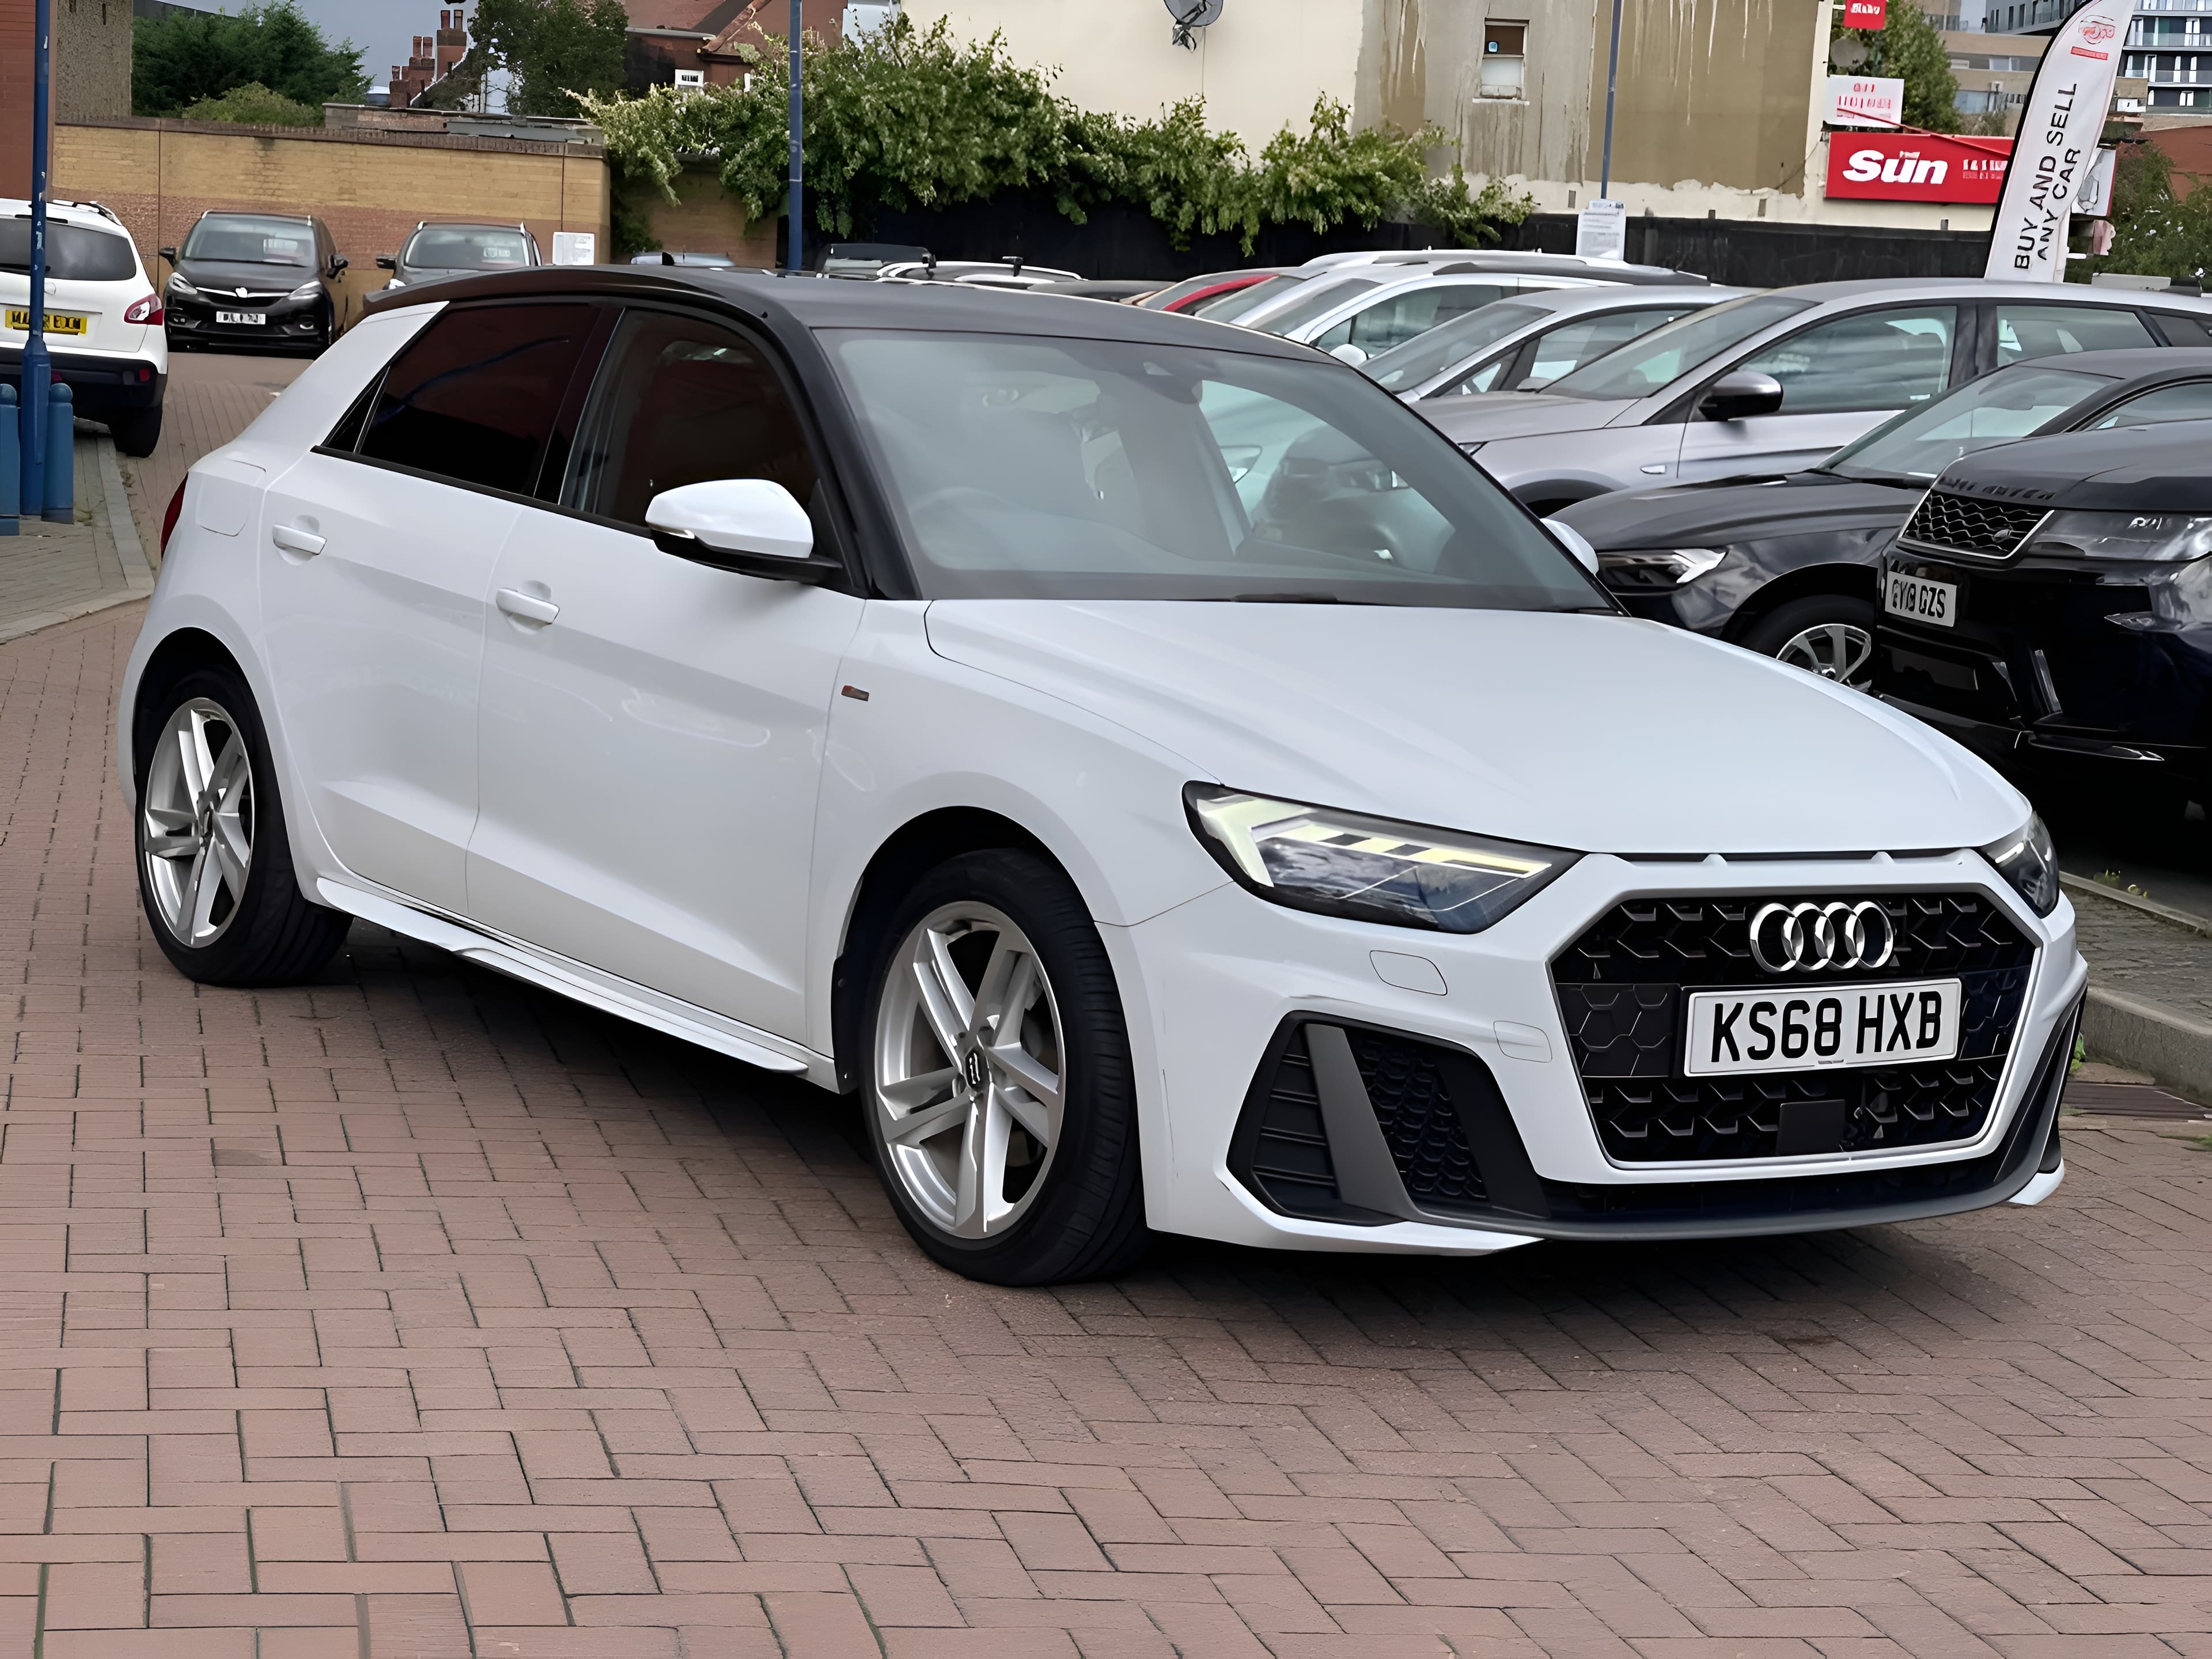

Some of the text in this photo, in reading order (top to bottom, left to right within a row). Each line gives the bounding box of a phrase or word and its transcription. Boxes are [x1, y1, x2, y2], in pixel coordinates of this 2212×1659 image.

[2014, 84, 2077, 269] BUY AND SELL
[2037, 148, 2081, 260] ANY CAR
[1710, 990, 1942, 1063] KS68 HXB
